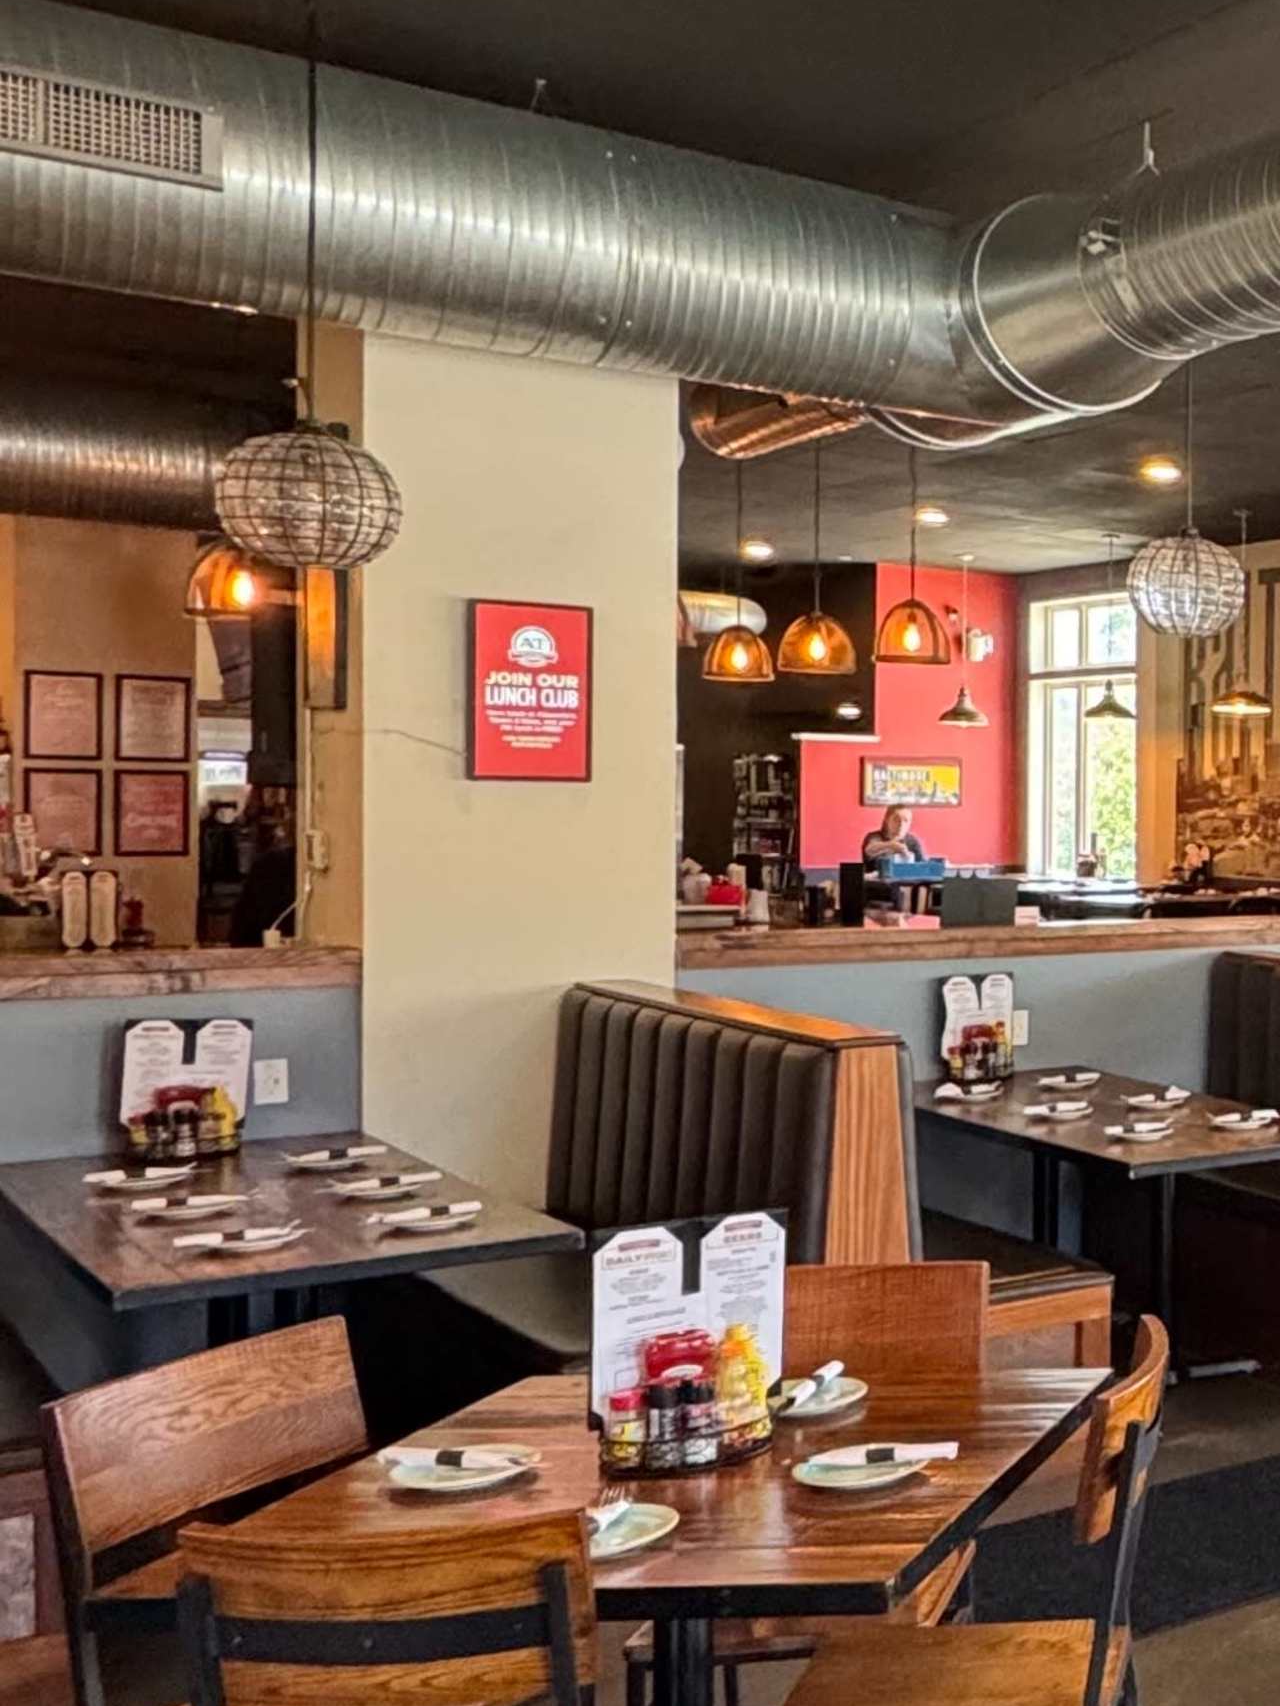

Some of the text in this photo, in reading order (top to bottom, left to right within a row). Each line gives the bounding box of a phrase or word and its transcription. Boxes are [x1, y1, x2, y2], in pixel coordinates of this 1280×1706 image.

[484, 670, 579, 689] JOIN OUR
[485, 685, 579, 710] LUNCH CLUB
